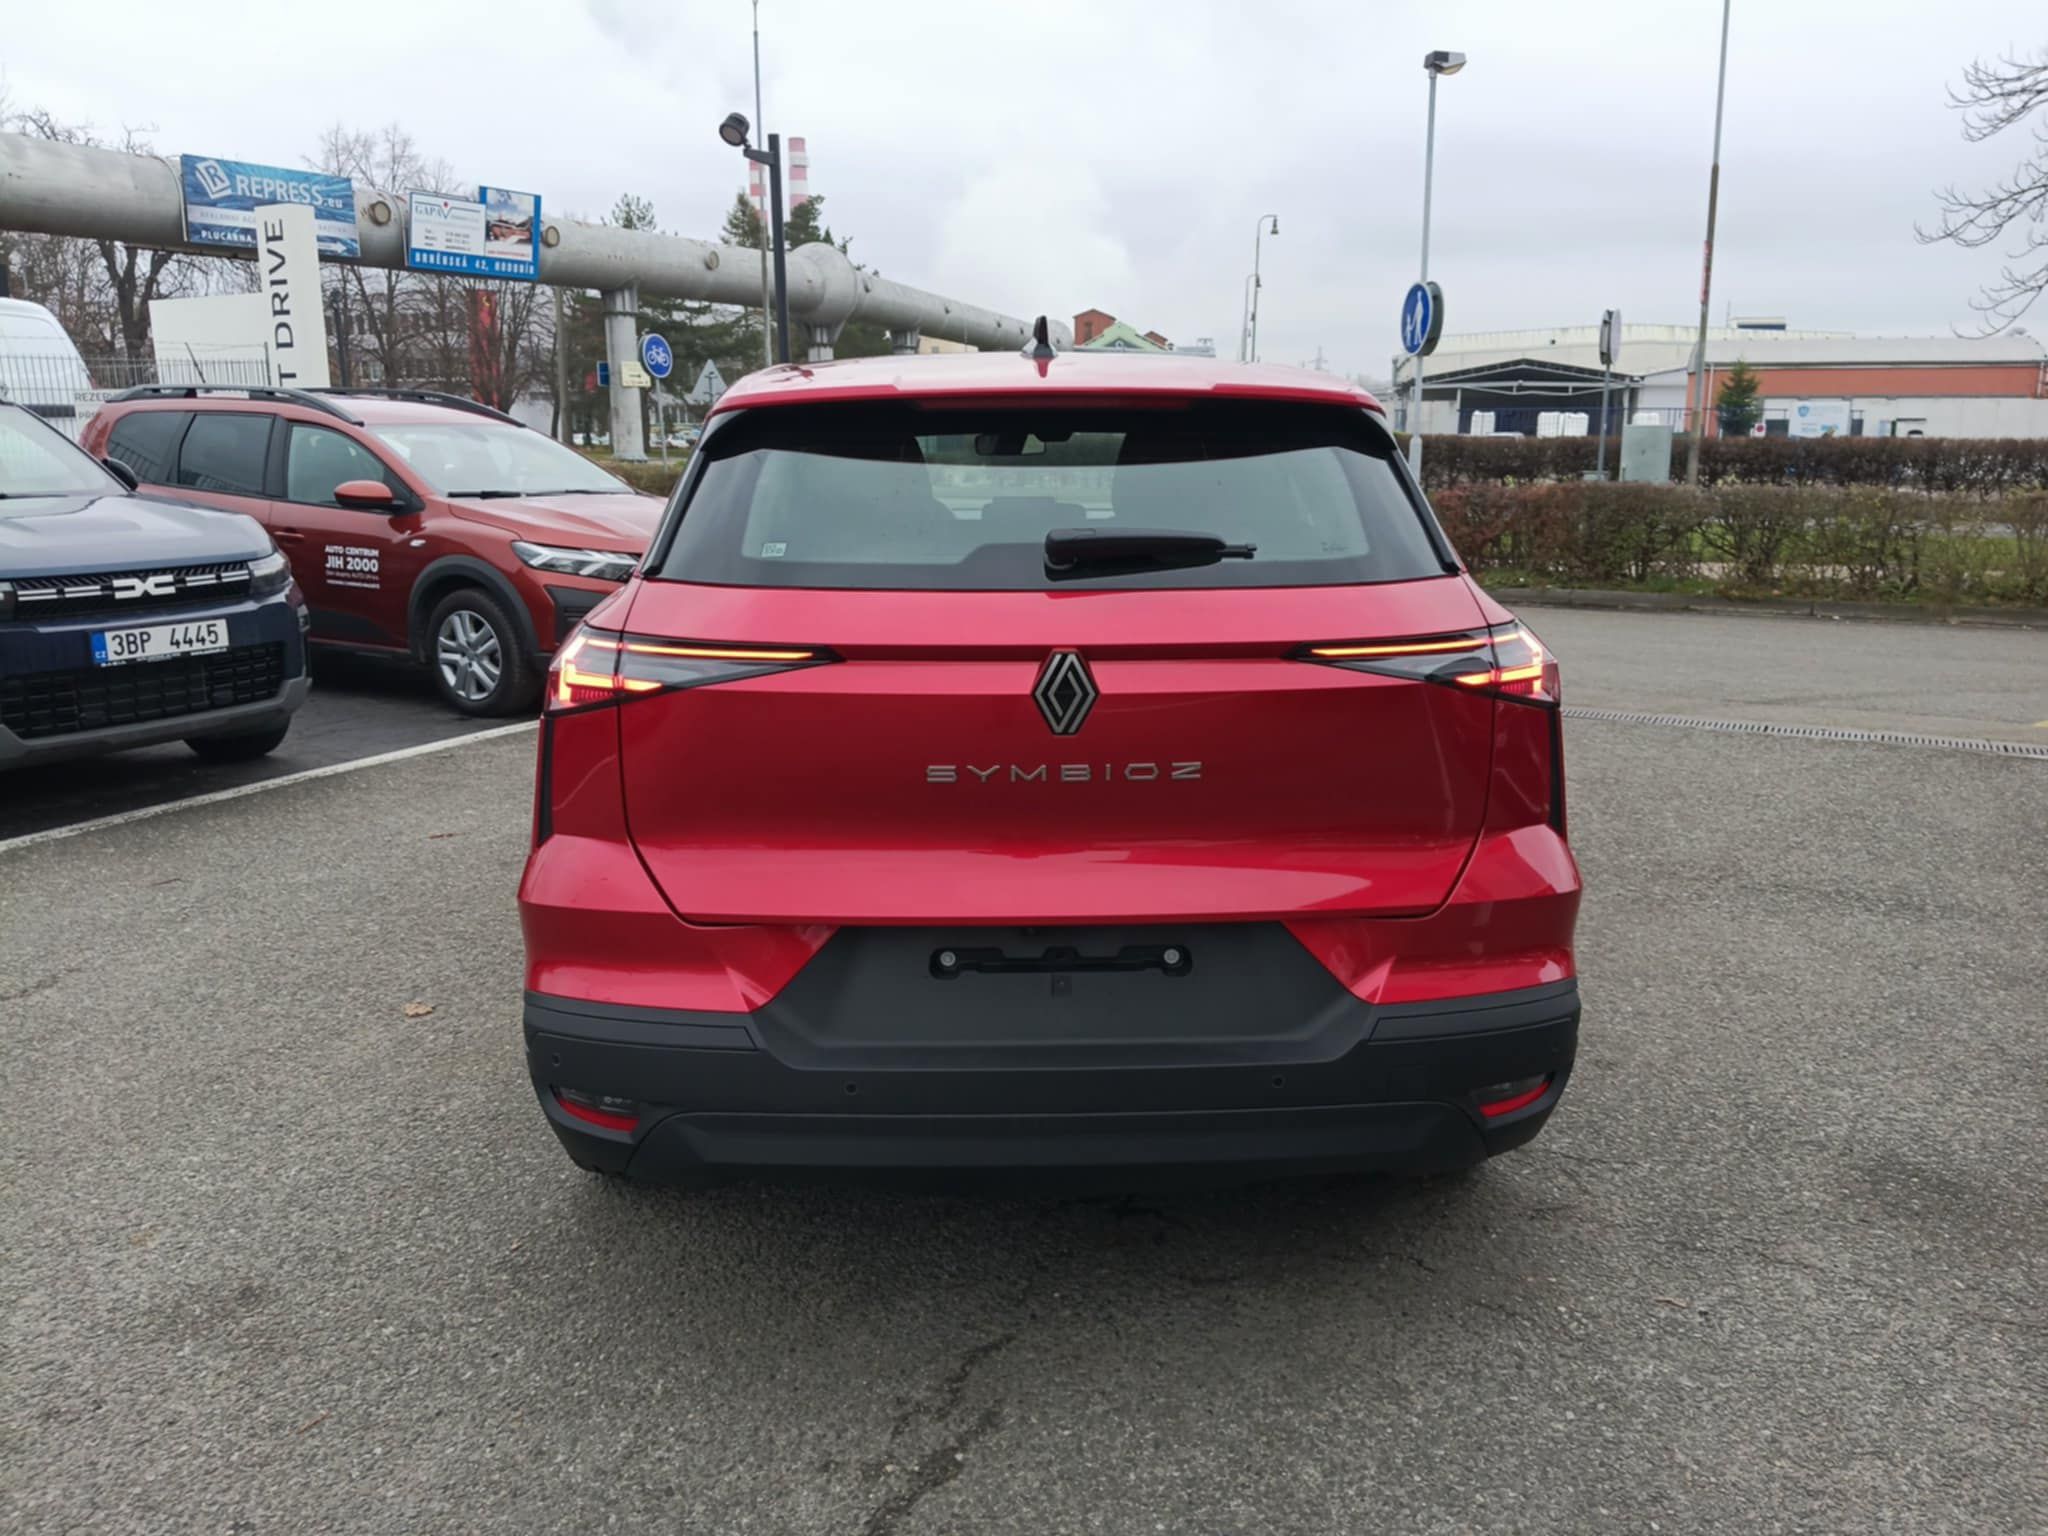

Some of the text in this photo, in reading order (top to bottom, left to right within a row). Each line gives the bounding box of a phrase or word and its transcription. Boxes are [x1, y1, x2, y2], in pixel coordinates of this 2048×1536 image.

[264, 218, 294, 350] DRIVE
[325, 555, 379, 573] JIH 2000
[111, 631, 151, 656] 3BP
[169, 623, 219, 649] 4445
